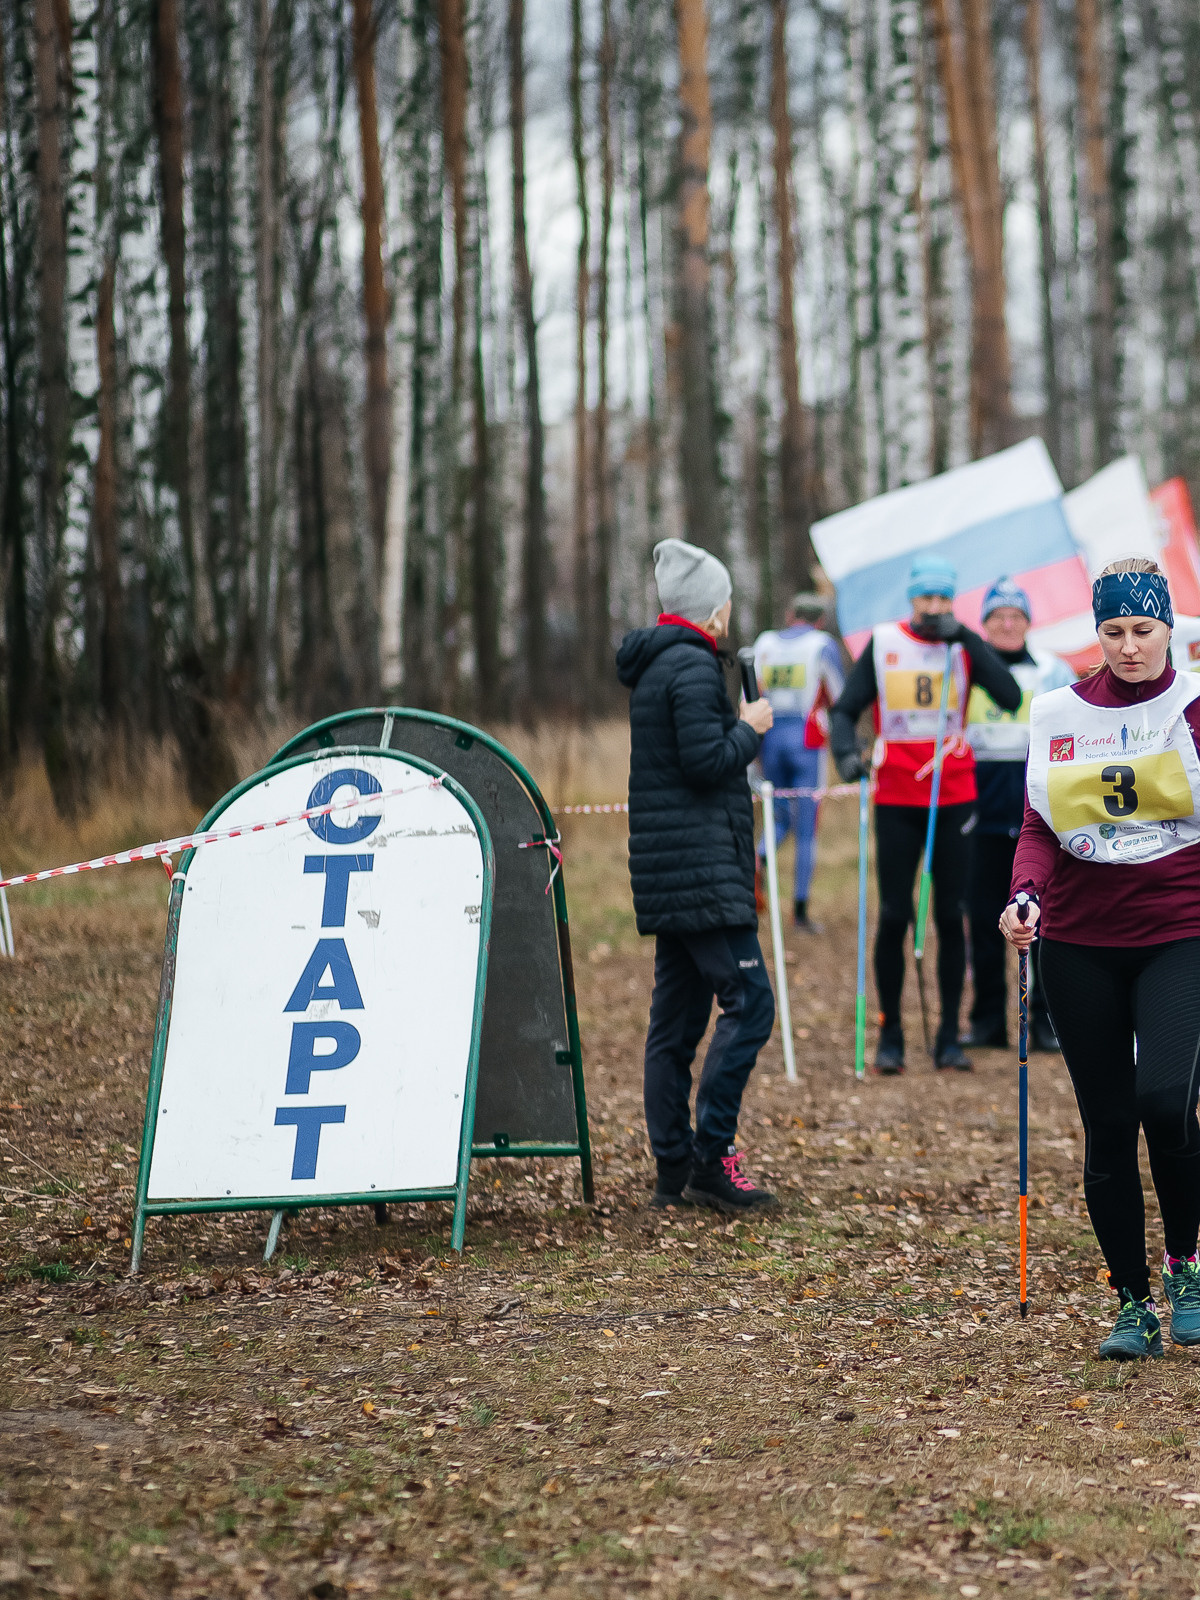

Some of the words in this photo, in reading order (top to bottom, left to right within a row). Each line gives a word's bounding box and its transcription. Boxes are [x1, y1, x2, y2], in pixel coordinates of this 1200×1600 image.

[915, 674, 933, 706] 8
[1077, 732, 1116, 748] Scandi
[1130, 725, 1159, 742] Vita
[1085, 752, 1109, 760] Nordic
[1110, 749, 1138, 757] Walking
[1101, 765, 1139, 817] 3
[274, 768, 384, 1181] СТАРТ
